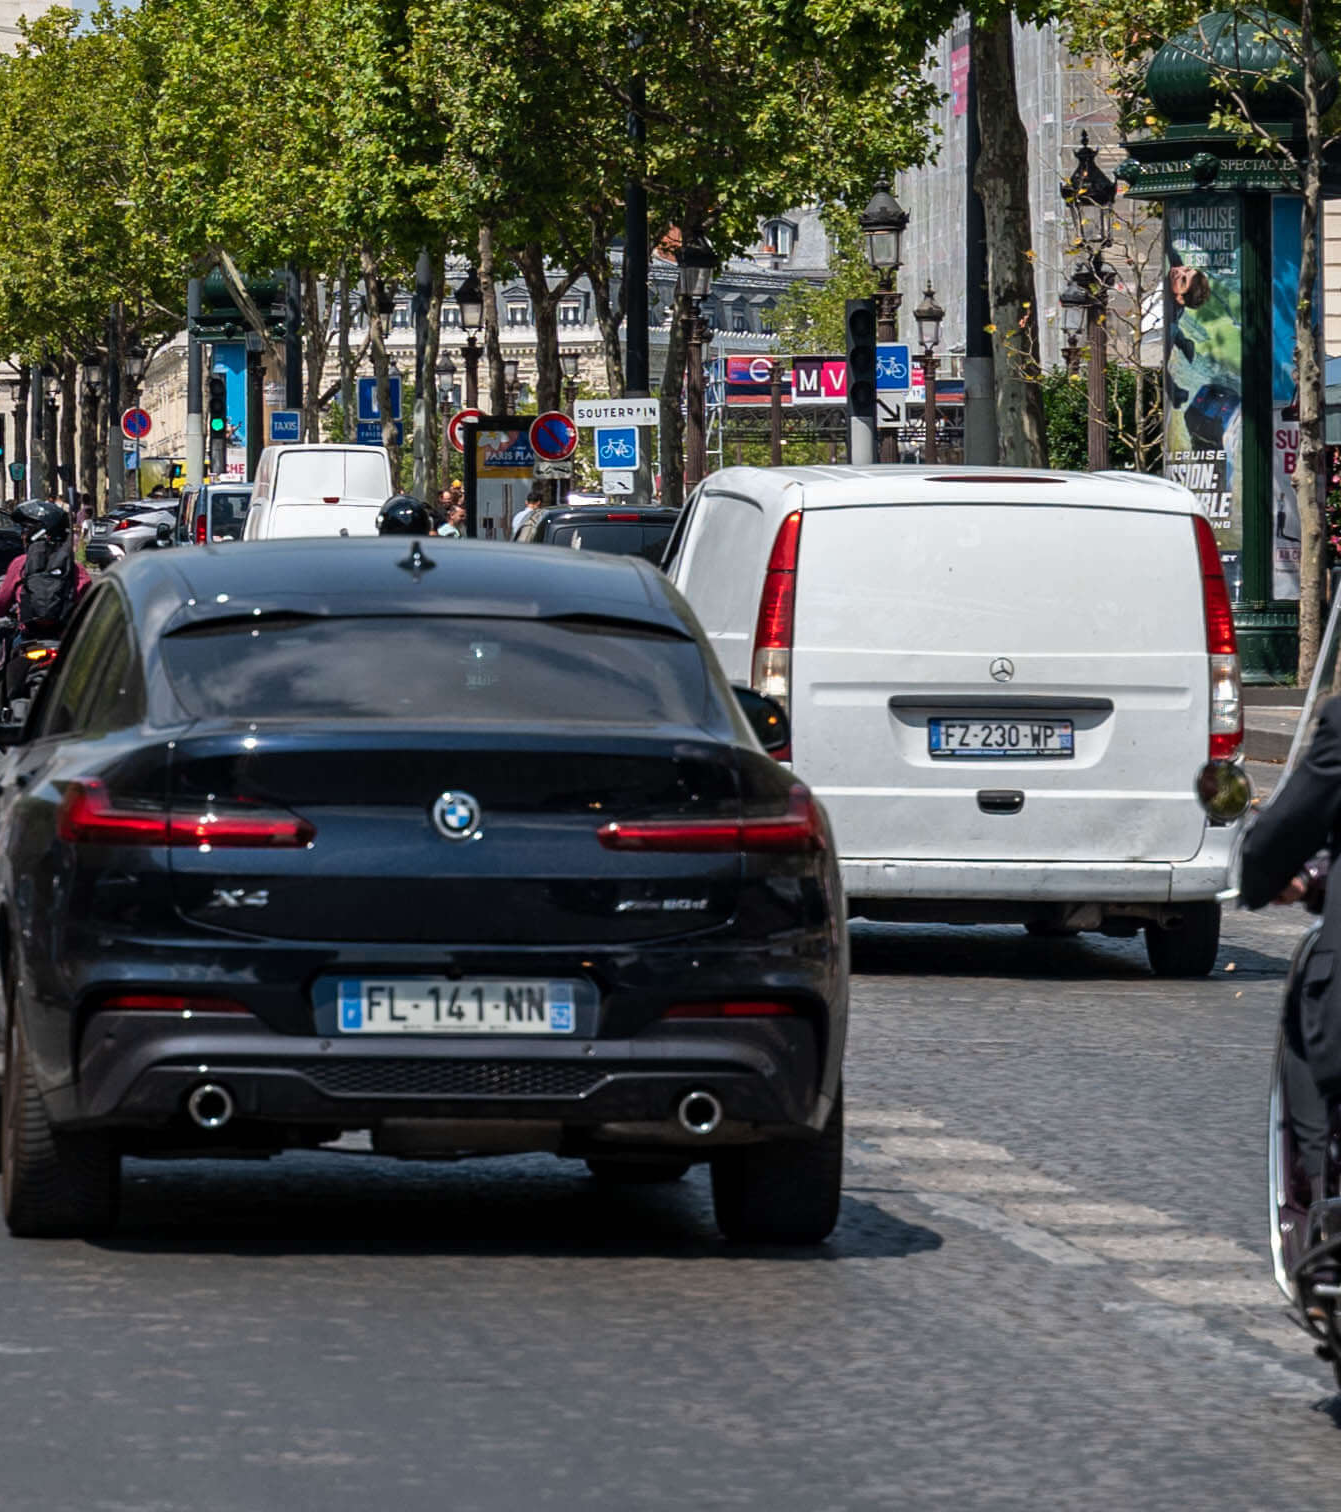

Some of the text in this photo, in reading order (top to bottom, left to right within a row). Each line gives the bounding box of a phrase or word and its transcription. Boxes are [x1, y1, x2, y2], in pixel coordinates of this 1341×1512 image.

[1188, 207, 1236, 230] CRUISE
[1189, 231, 1236, 251] SOMMET
[578, 407, 657, 419] SOUTERRIN
[274, 421, 297, 431] TAXIS
[485, 451, 514, 461] PARIS
[1175, 449, 1227, 461] CRUISE
